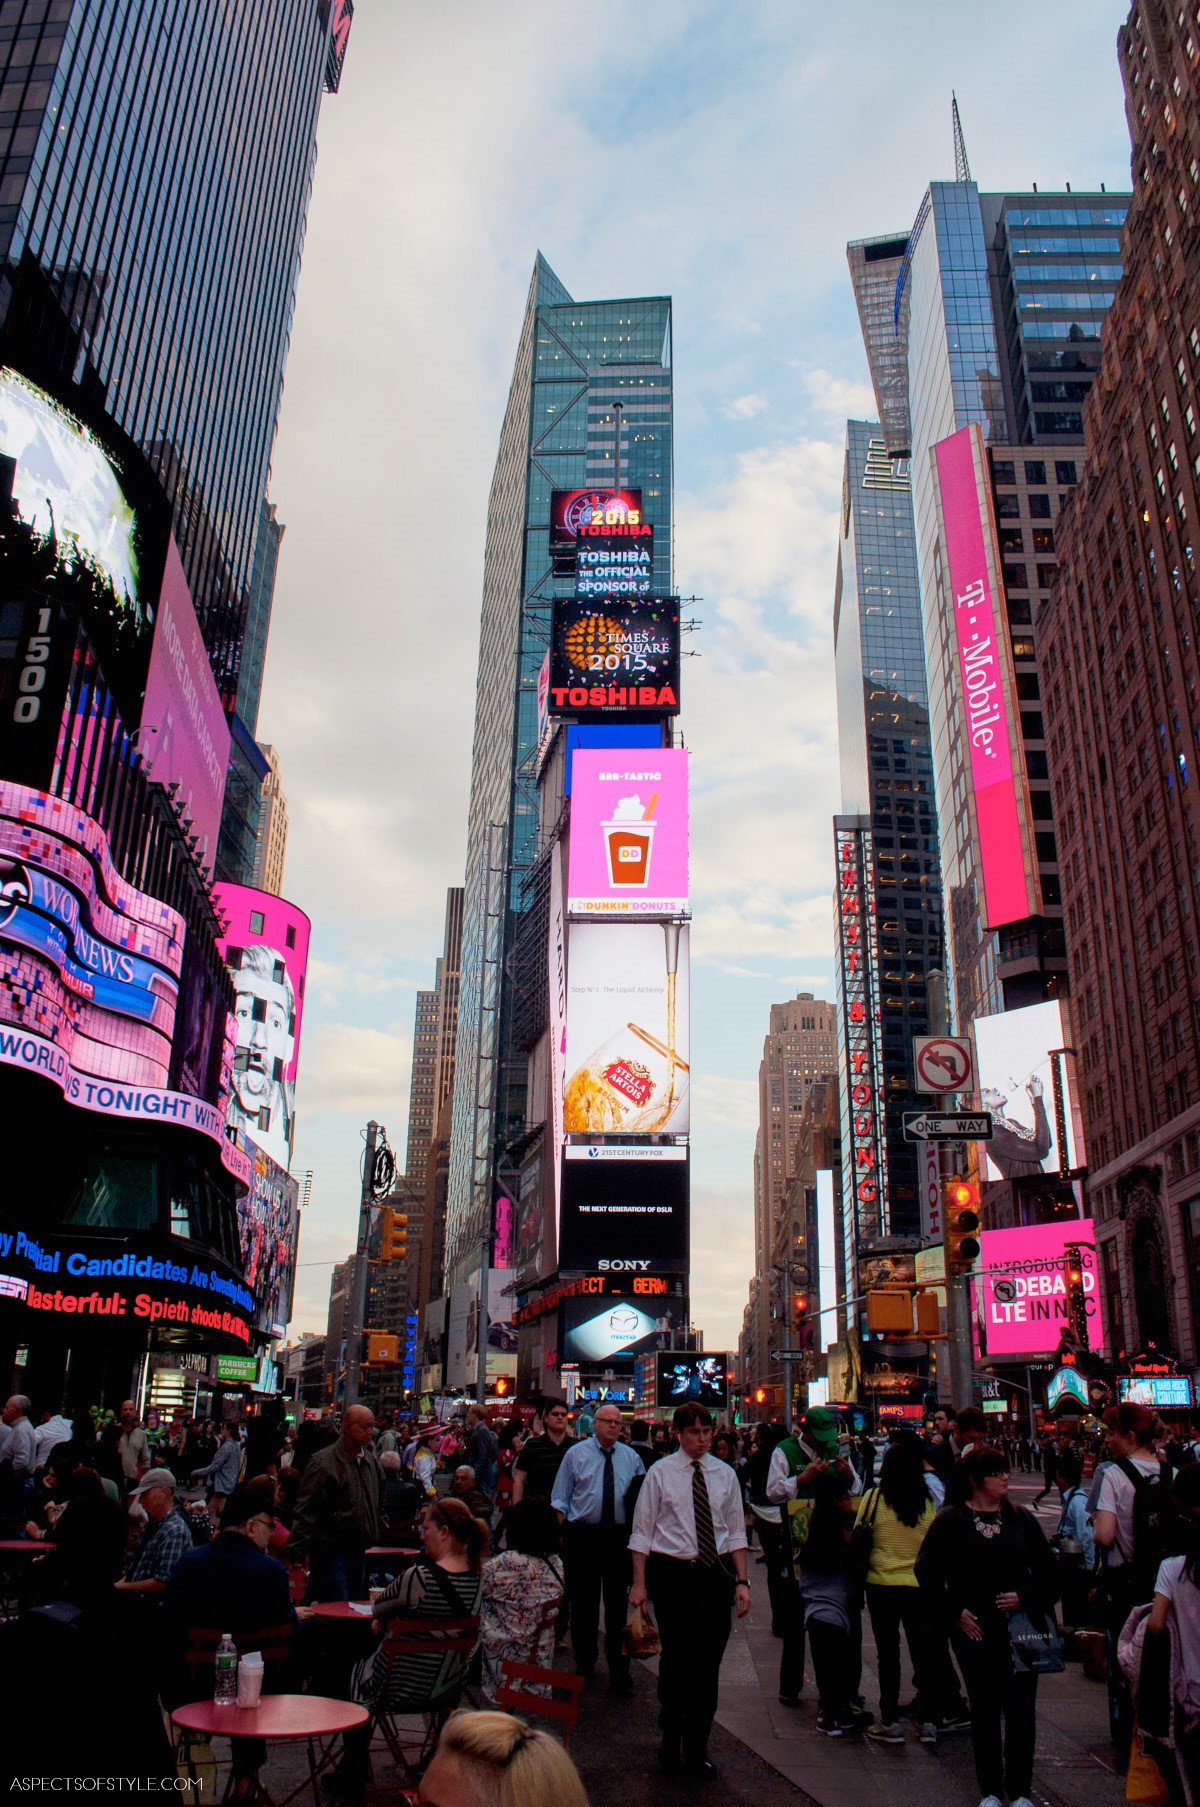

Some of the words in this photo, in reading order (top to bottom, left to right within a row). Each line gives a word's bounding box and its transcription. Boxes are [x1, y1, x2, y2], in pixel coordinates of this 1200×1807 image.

[591, 510, 640, 525] 2015
[577, 524, 652, 536] TOSHIBA
[578, 551, 651, 563] TOSHIBA
[579, 570, 594, 578] THE
[595, 566, 650, 577] OFFICIAL
[578, 581, 638, 593] SPONSOR
[606, 633, 649, 644] TIMES
[614, 643, 671, 656] SQUARE
[13, 607, 52, 723] 1500
[589, 654, 648, 671] 2015
[552, 687, 677, 706] TOSHIBA
[598, 772, 662, 781] BRR-TASTIC
[614, 1066, 647, 1094] STELLA
[608, 1073, 643, 1101] ARTOIS
[86, 1083, 192, 1120] TONIGHT
[194, 1103, 221, 1132] WITH
[916, 1121, 942, 1132] ONE
[956, 1121, 984, 1132] WAY
[66, 1253, 188, 1284] Candidates
[598, 1259, 651, 1270] SONY
[989, 1253, 1093, 1277] INTRODUCG
[133, 1293, 189, 1322] Spieth
[191, 1303, 222, 1330] shoots
[991, 1301, 1027, 1323] LTE
[1055, 1296, 1097, 1319] NC
[218, 1359, 257, 1369] TARBUCKS
[220, 1367, 247, 1376] COFFEE
[1018, 1632, 1053, 1641] SEPHORA
